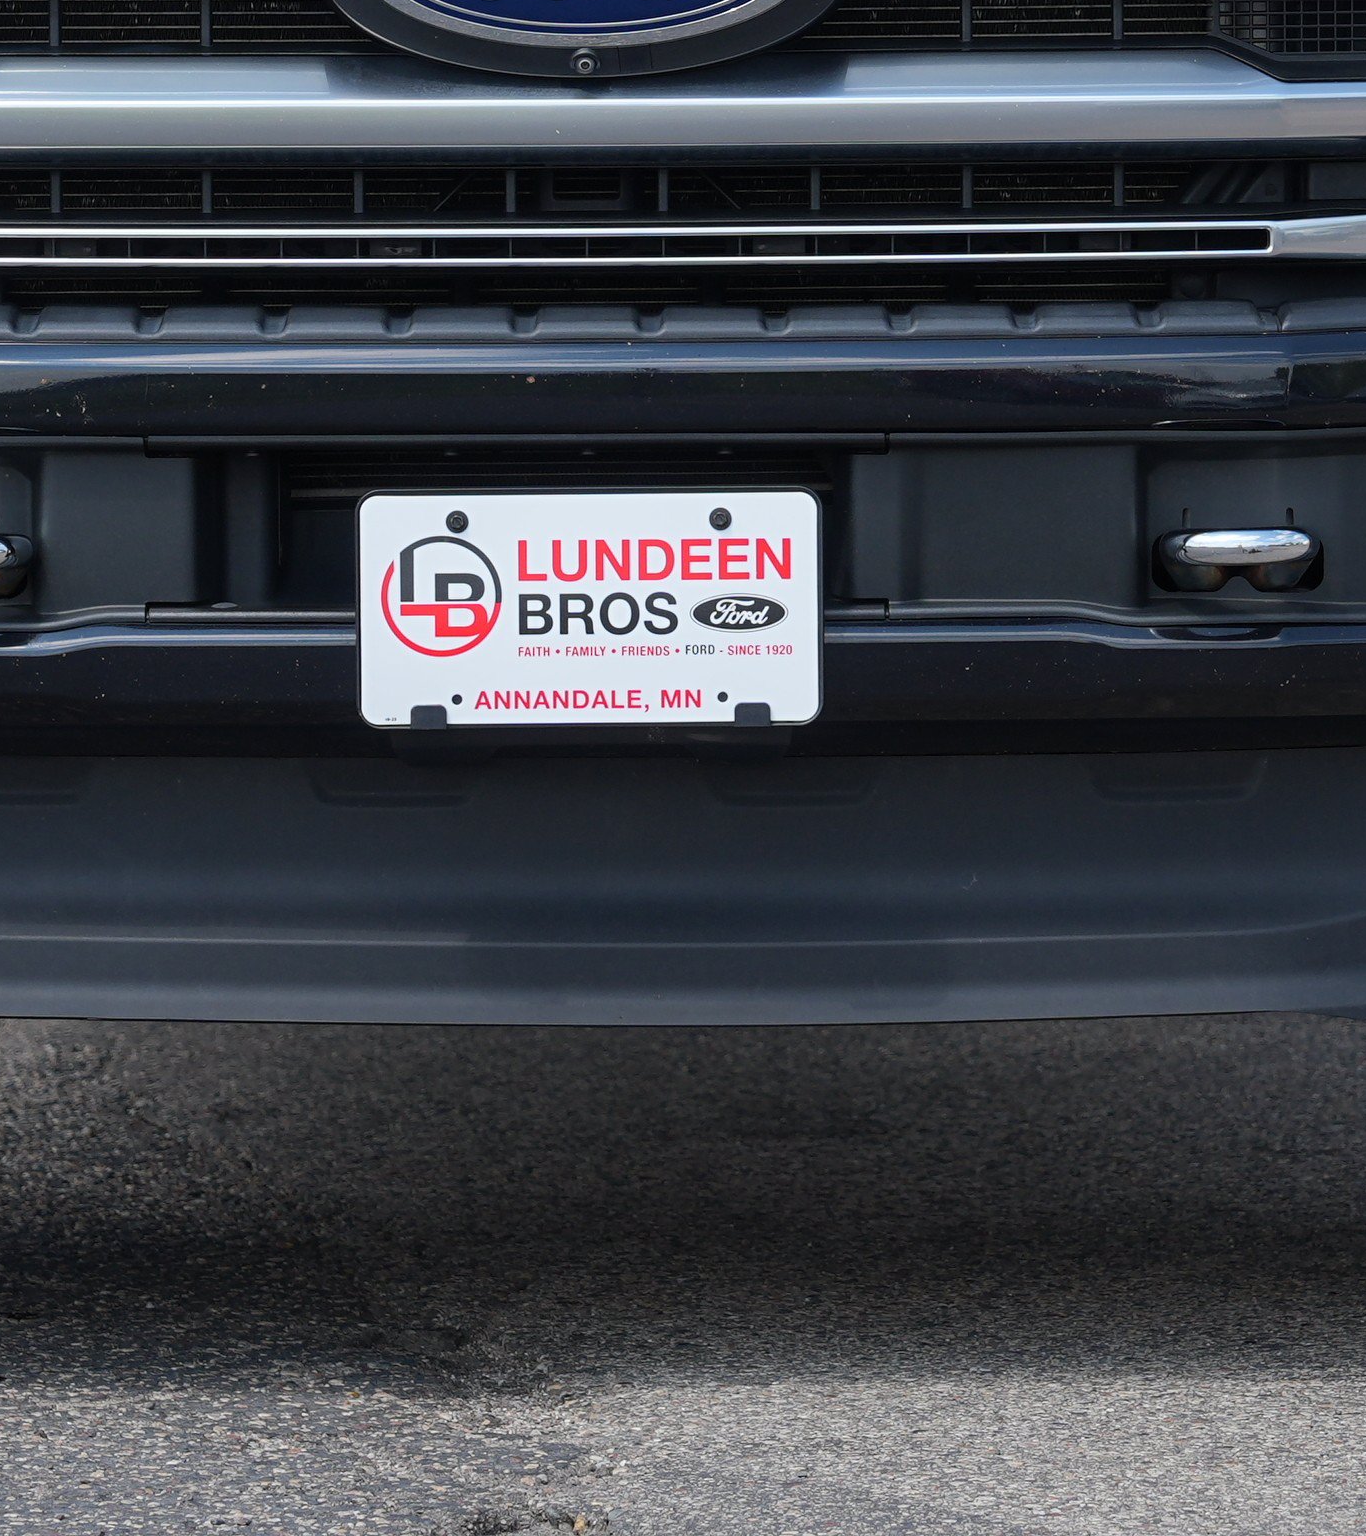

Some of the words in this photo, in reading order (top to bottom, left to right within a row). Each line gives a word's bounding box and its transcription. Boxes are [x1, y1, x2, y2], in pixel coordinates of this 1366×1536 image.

[517, 538, 792, 582] LUNDEEN
[518, 592, 679, 636] BROS
[709, 598, 770, 625] Ford
[518, 646, 551, 657] FAITH
[565, 645, 607, 657] FAMILY
[621, 645, 671, 657] FRIENDS
[685, 644, 716, 656] FORD
[727, 644, 761, 656] SINCE
[765, 644, 793, 656] 1920
[474, 690, 650, 713] ANNANDALE,
[660, 689, 702, 709] MN
